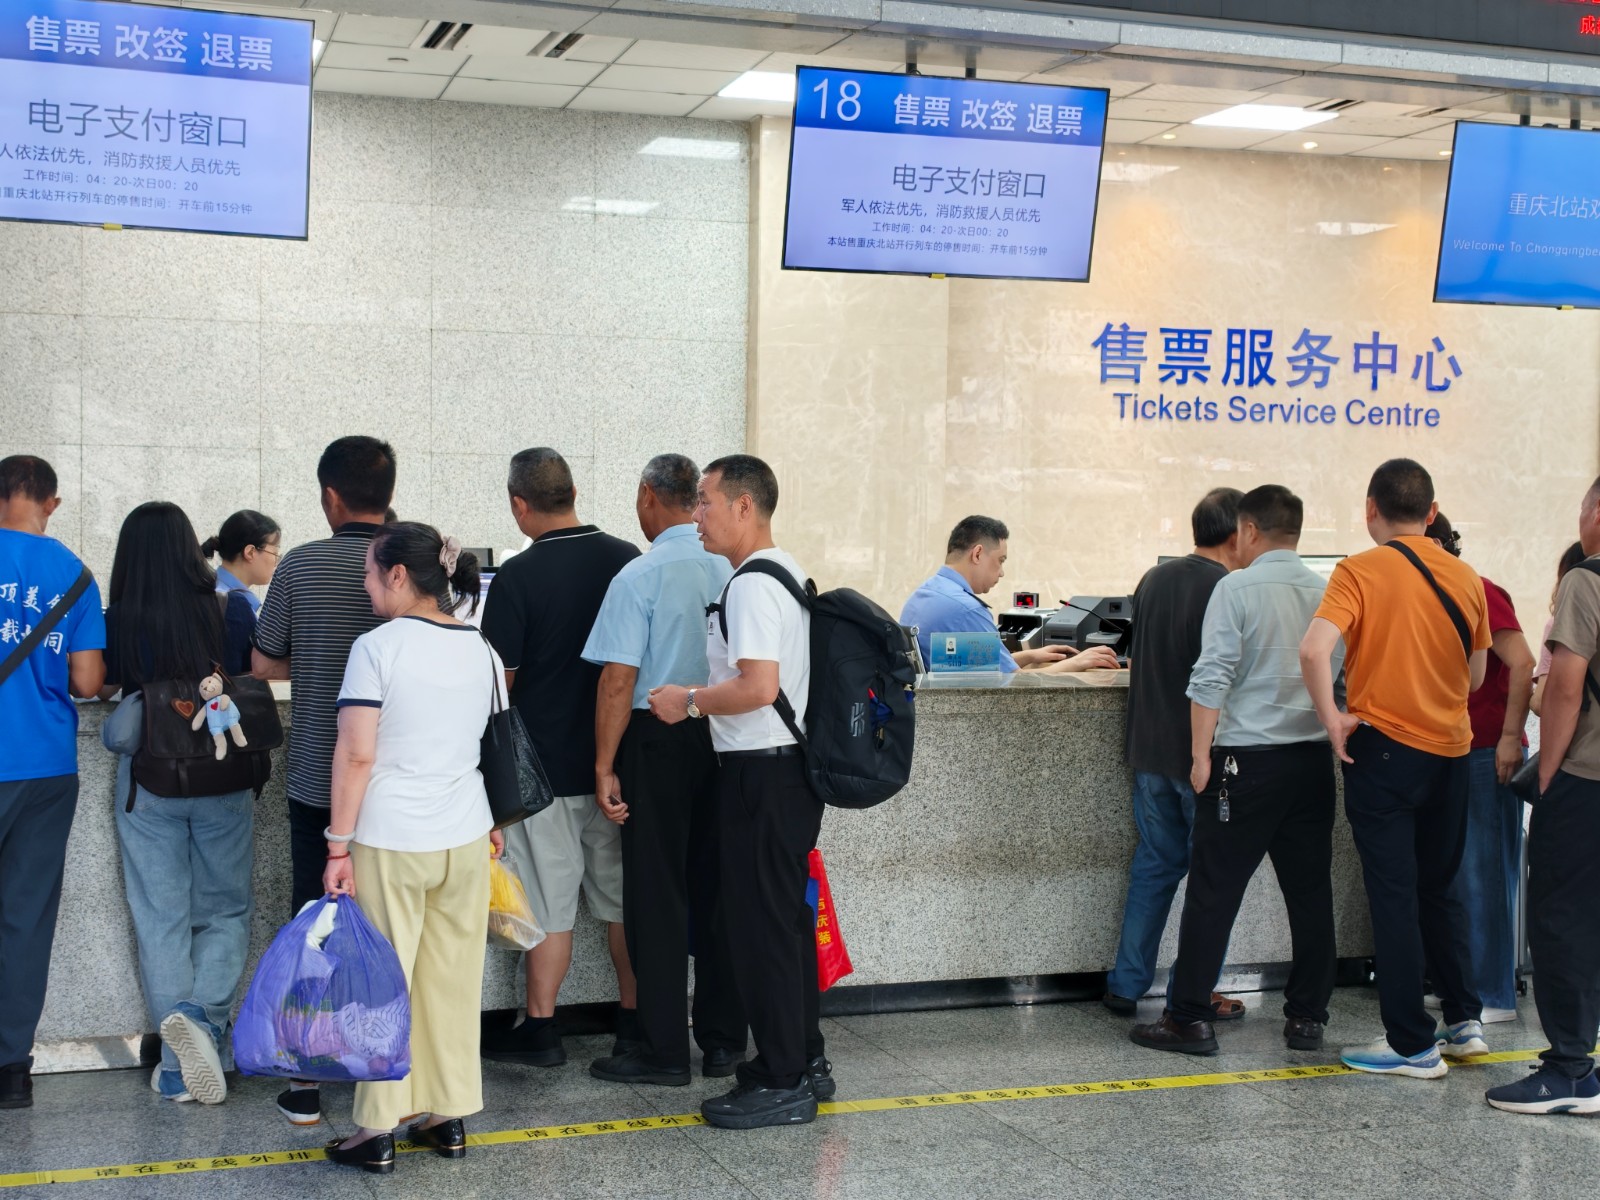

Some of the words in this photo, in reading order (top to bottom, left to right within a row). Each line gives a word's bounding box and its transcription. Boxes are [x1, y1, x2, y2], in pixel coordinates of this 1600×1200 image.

[26, 15, 101, 56] 售票
[115, 24, 188, 63] 改签
[201, 31, 273, 72] 退票
[813, 78, 862, 121] 18
[893, 93, 950, 128] 售票
[960, 99, 1018, 132] 改签
[1026, 103, 1084, 137] 退票
[28, 98, 247, 149] 电子支付窗口
[0, 186, 253, 215] 重庆北站开行列车的停售时间：开车前15分钟
[892, 163, 1046, 199] 电子支付窗口
[1453, 239, 1505, 252] Welcome
[1510, 241, 1522, 254] To
[1091, 322, 1463, 393] 售票服务中心
[1113, 392, 1219, 421] Tickets
[1228, 395, 1336, 424] Service
[1345, 399, 1441, 427] Centre
